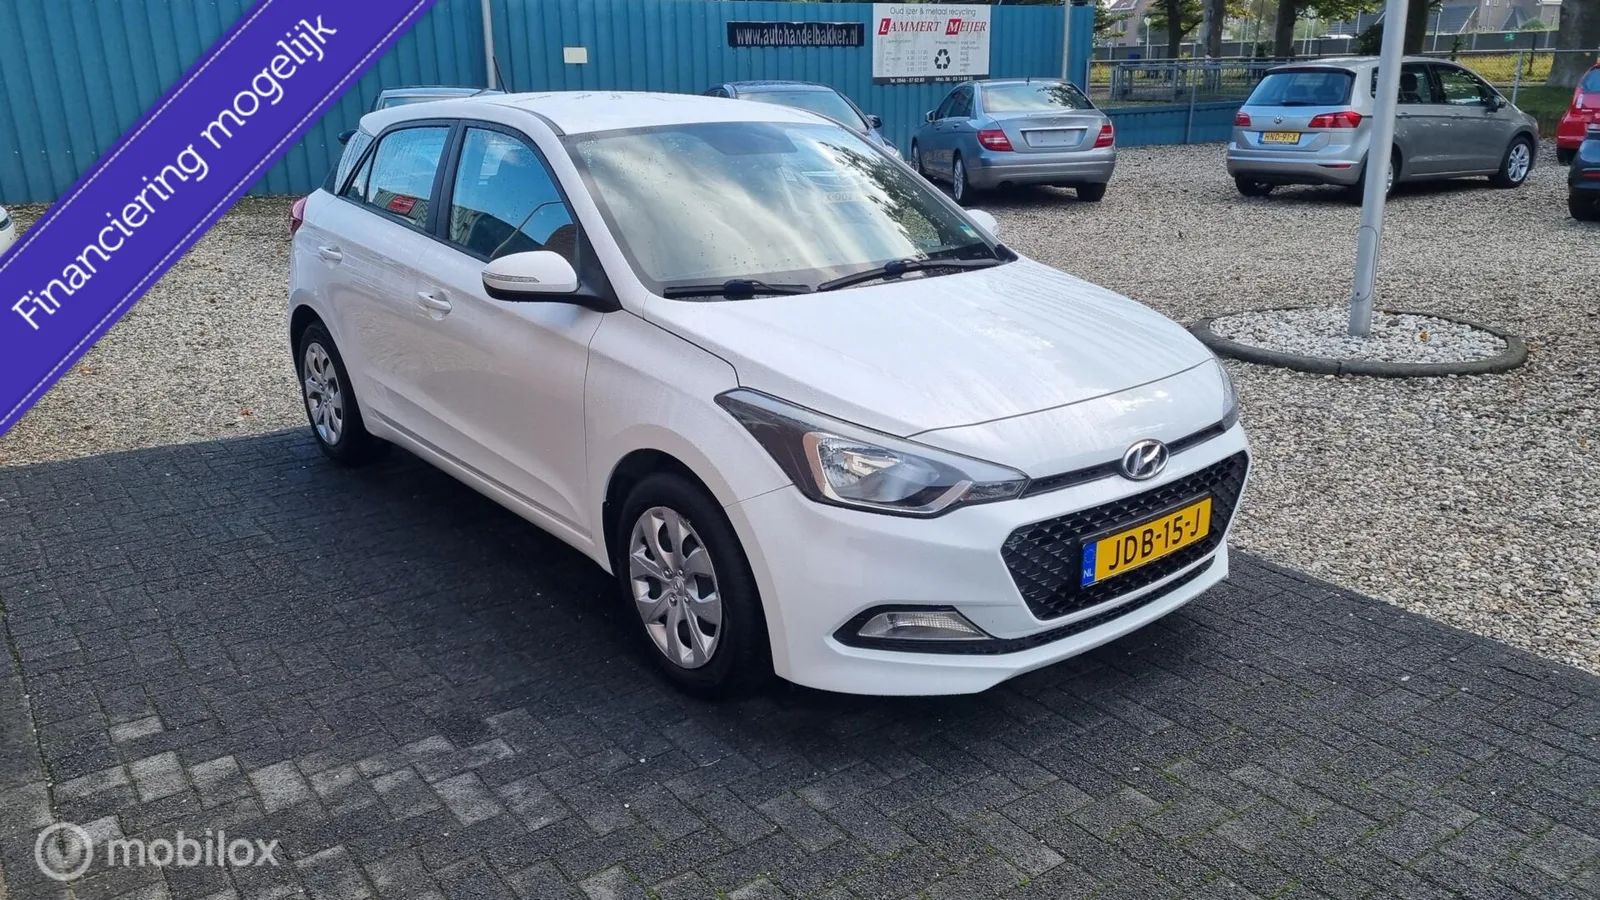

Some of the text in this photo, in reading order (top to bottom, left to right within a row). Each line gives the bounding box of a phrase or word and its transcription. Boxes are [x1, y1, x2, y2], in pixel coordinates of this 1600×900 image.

[890, 7, 904, 15] Oud
[948, 8, 976, 17] recycling
[879, 20, 987, 34] LAMMERT MEIJER
[736, 24, 858, 45] www.autohandelbakker.nl
[1264, 132, 1297, 141] HND-91-X
[1108, 508, 1200, 571] JDB-15-J
[1083, 568, 1094, 579] NL
